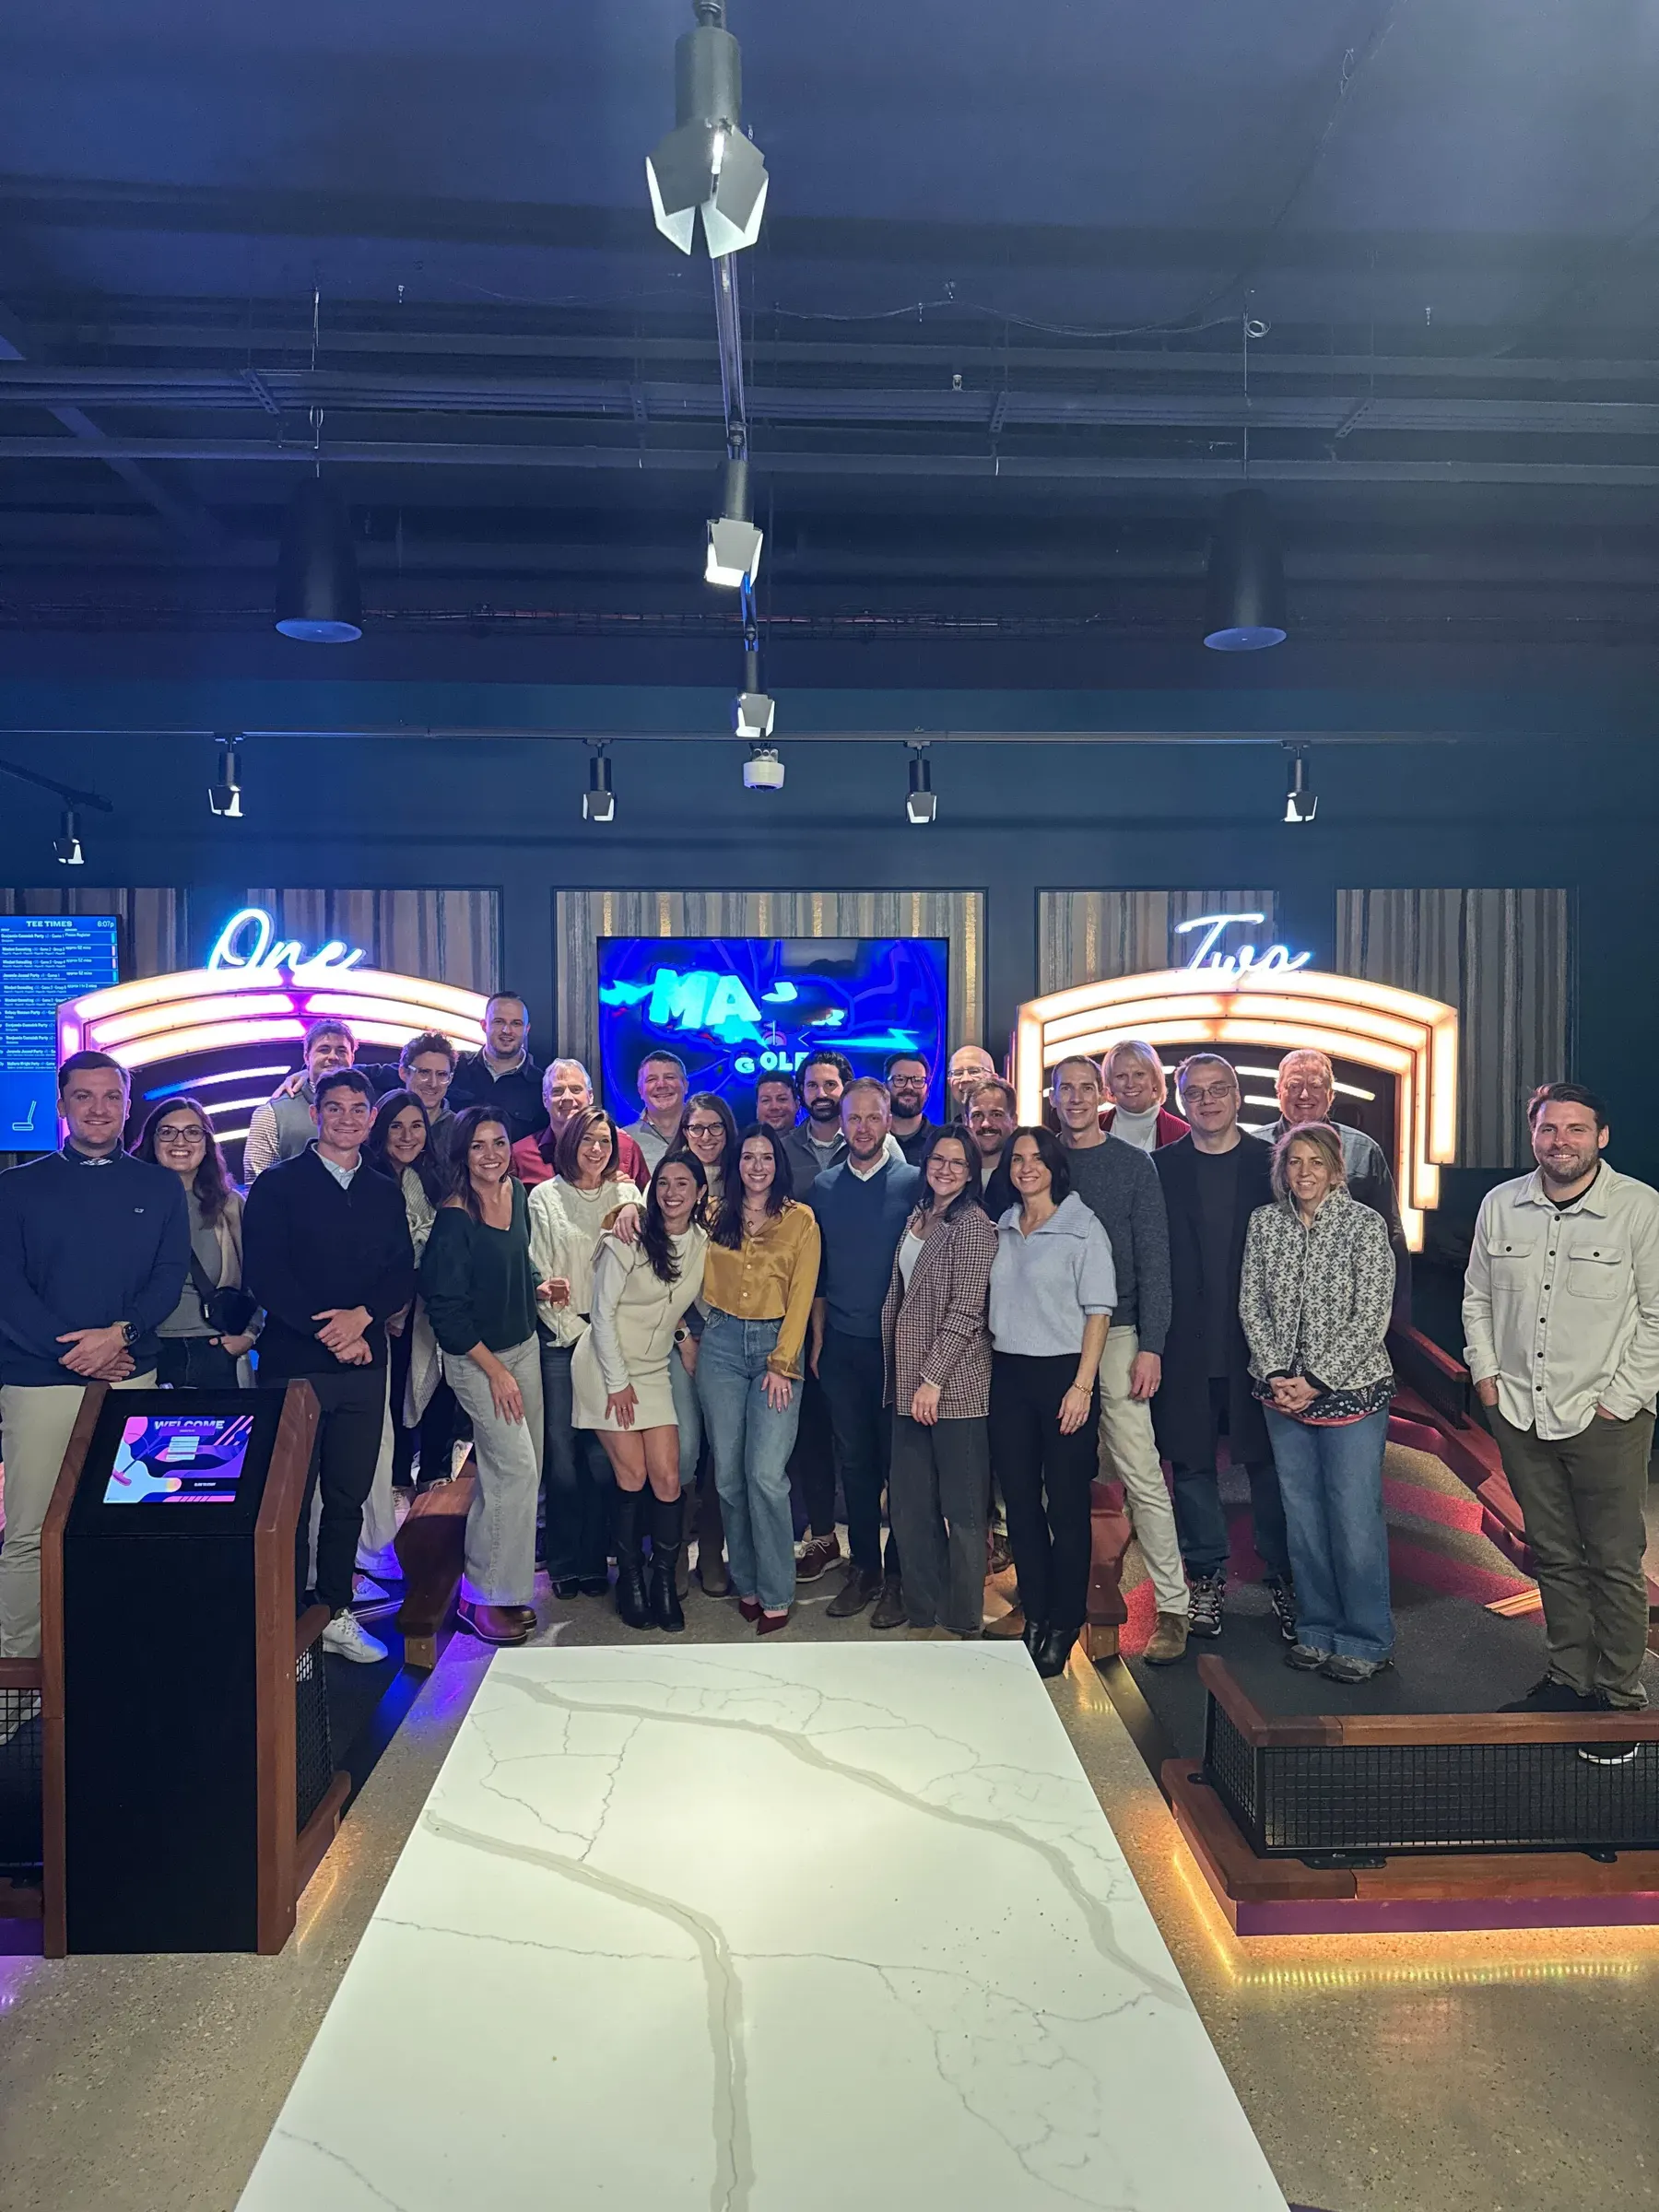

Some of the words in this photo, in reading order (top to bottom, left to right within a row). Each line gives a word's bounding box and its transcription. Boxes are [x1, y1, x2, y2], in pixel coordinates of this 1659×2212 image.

[208, 908, 366, 971] One
[1175, 913, 1312, 974] Two
[154, 1420, 225, 1430] WELCOME
